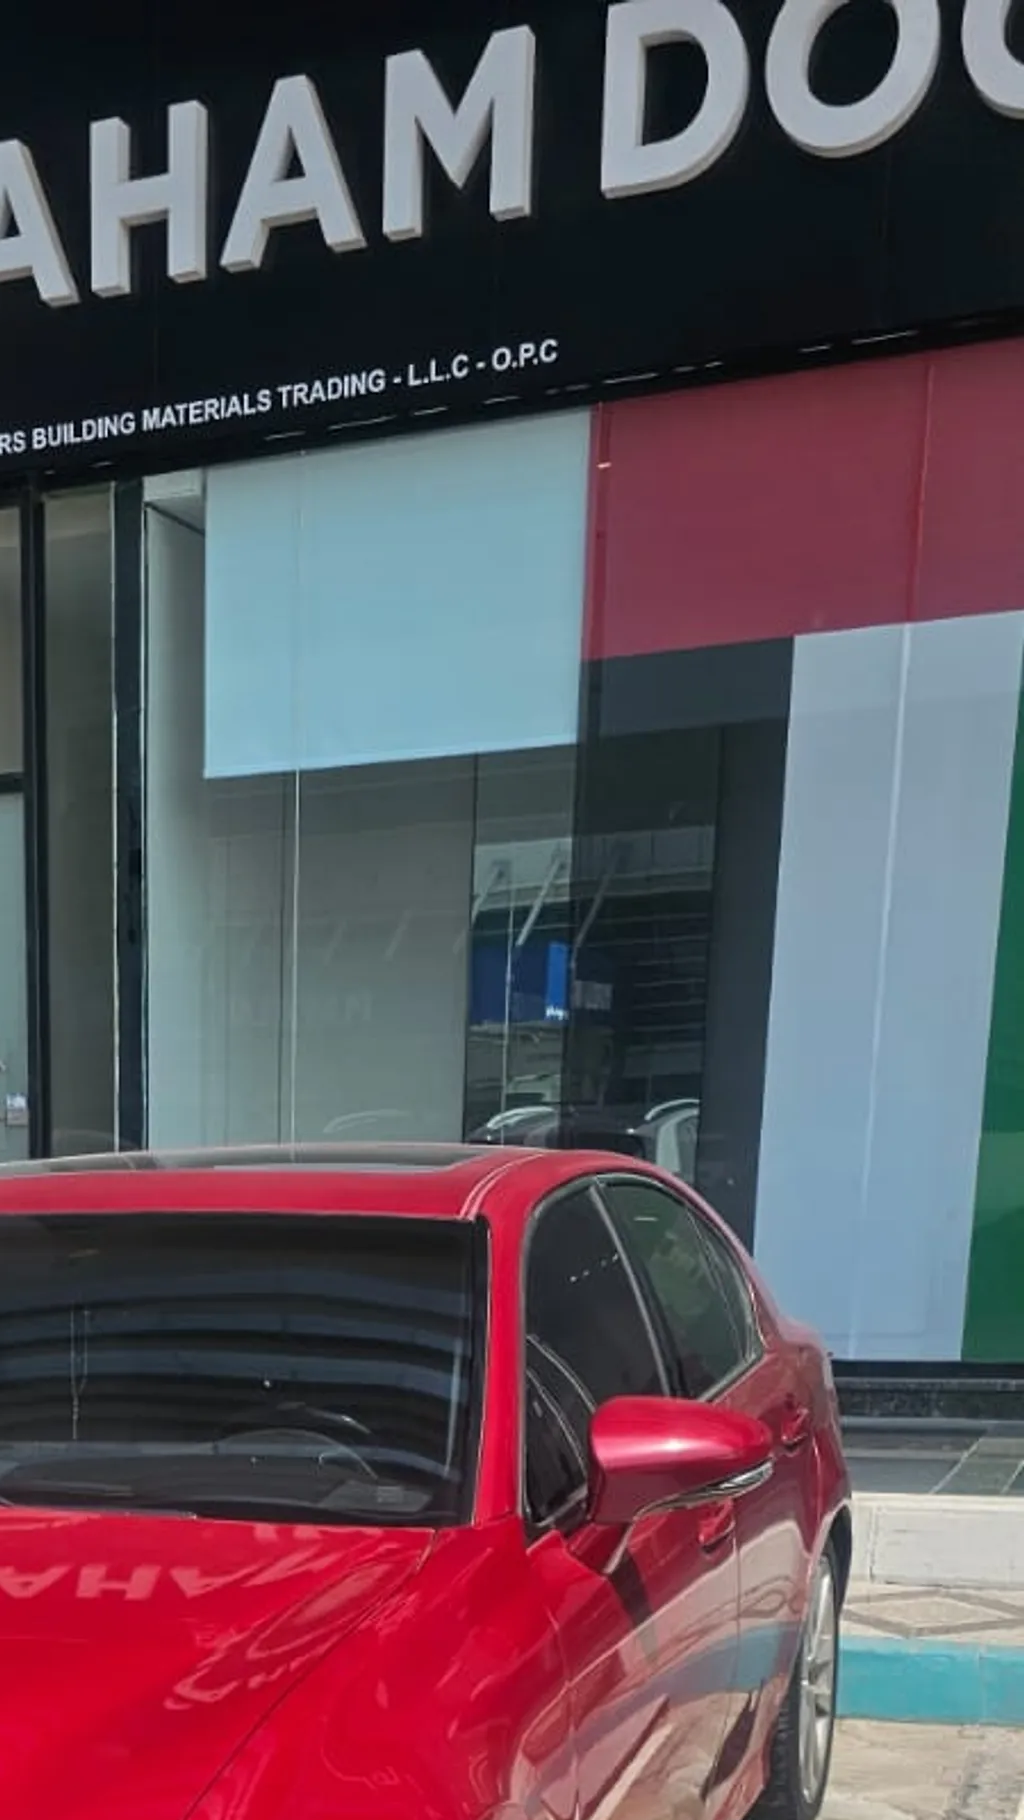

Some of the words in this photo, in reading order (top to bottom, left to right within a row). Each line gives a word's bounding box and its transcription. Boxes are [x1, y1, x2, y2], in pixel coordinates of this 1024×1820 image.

[31, 411, 136, 450] BUILDING
[142, 388, 272, 432] MATERIALS
[276, 368, 386, 409] TRADING
[407, 354, 469, 387] L.L.C
[491, 338, 558, 371] O.P.C
